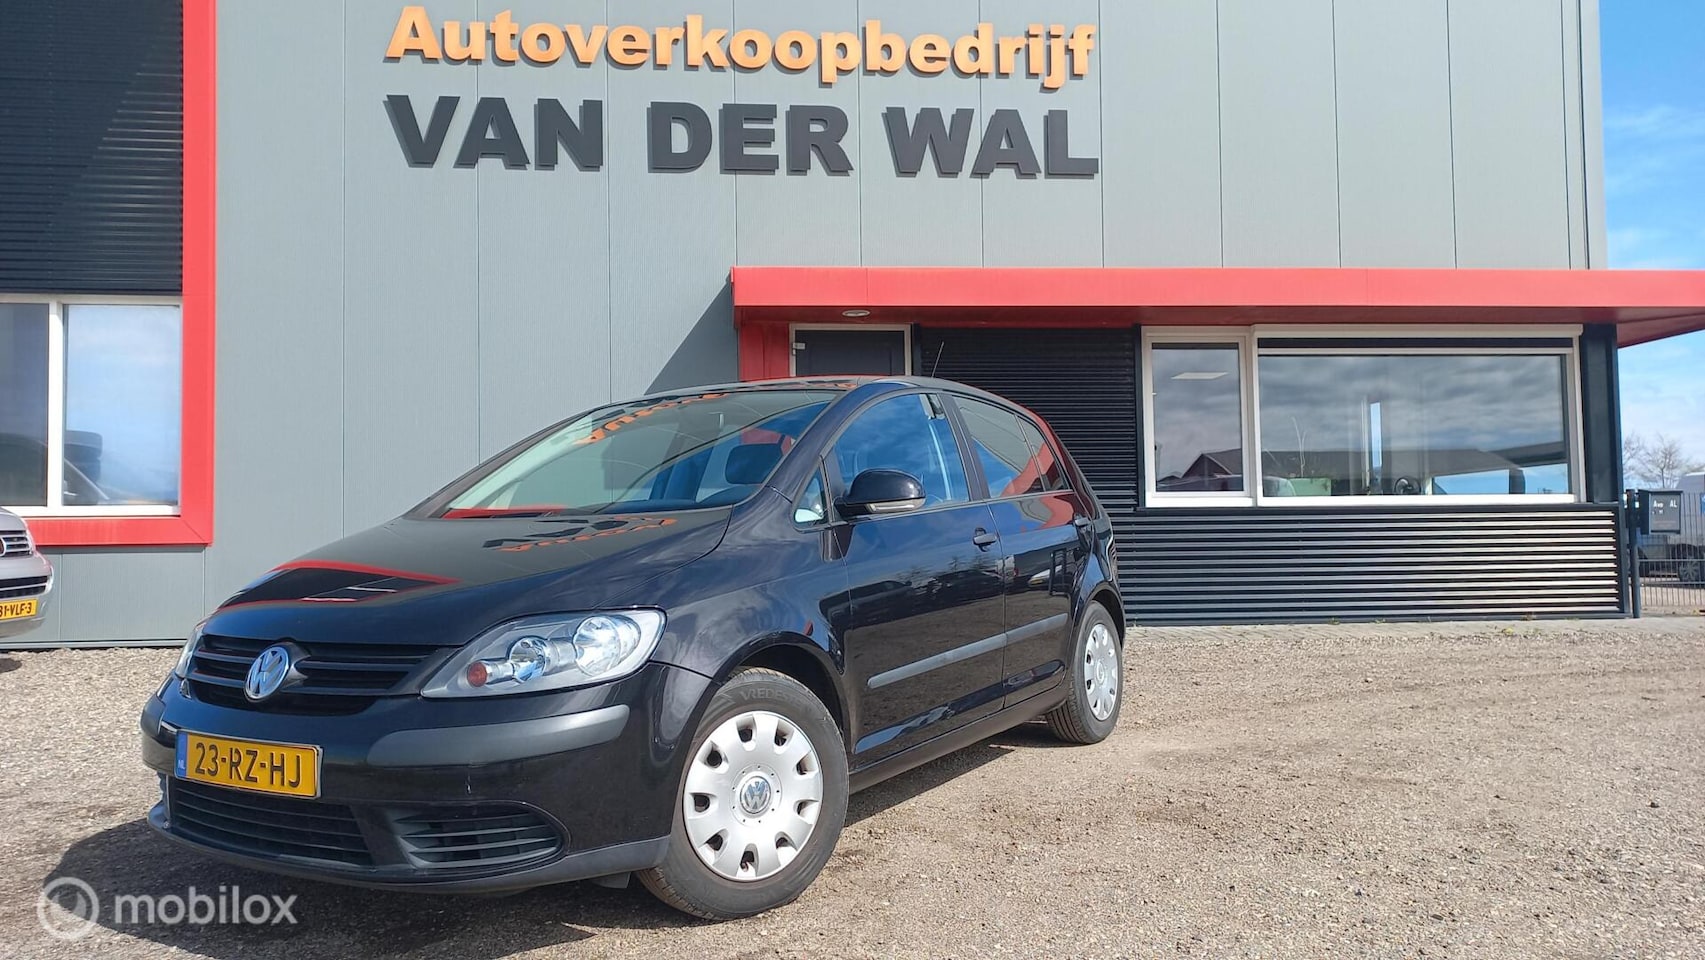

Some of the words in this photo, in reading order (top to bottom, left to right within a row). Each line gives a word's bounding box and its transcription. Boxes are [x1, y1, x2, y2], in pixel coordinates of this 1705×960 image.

[385, 6, 1097, 89] Autoverkoopbedrijf
[387, 94, 602, 169] VAN
[649, 101, 854, 175] DER
[887, 107, 1099, 177] WAL
[194, 742, 301, 788] 23-RZ-HJ
